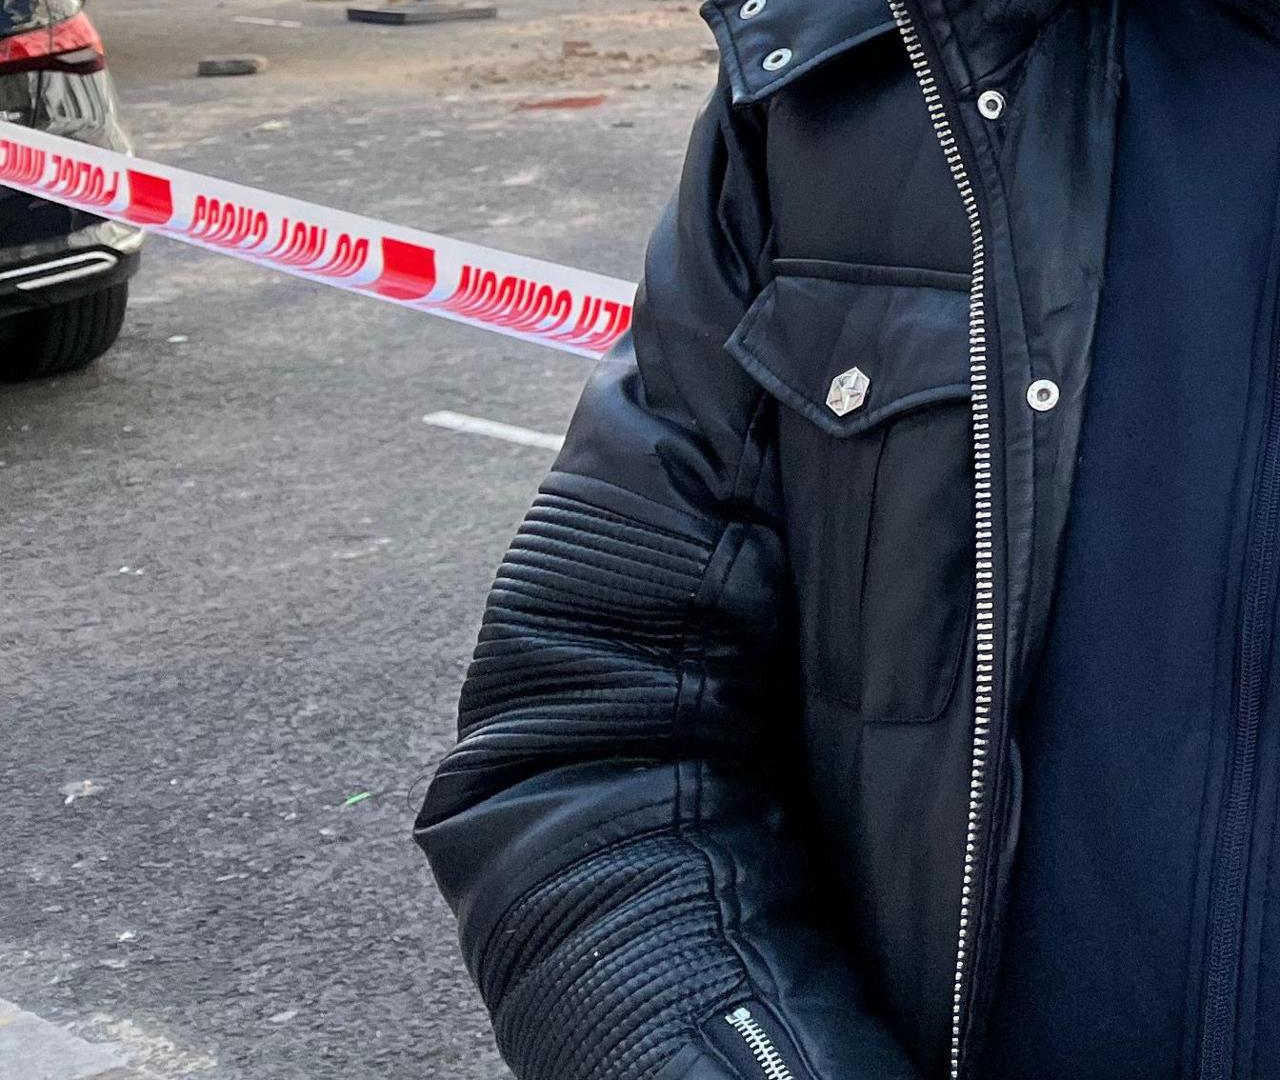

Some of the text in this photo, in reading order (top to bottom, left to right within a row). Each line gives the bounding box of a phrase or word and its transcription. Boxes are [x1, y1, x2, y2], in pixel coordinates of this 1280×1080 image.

[45, 153, 120, 208] POLICE
[186, 194, 269, 254] CROSS
[271, 216, 328, 268] NOT
[318, 233, 370, 278] DO
[440, 264, 573, 333] CORDON
